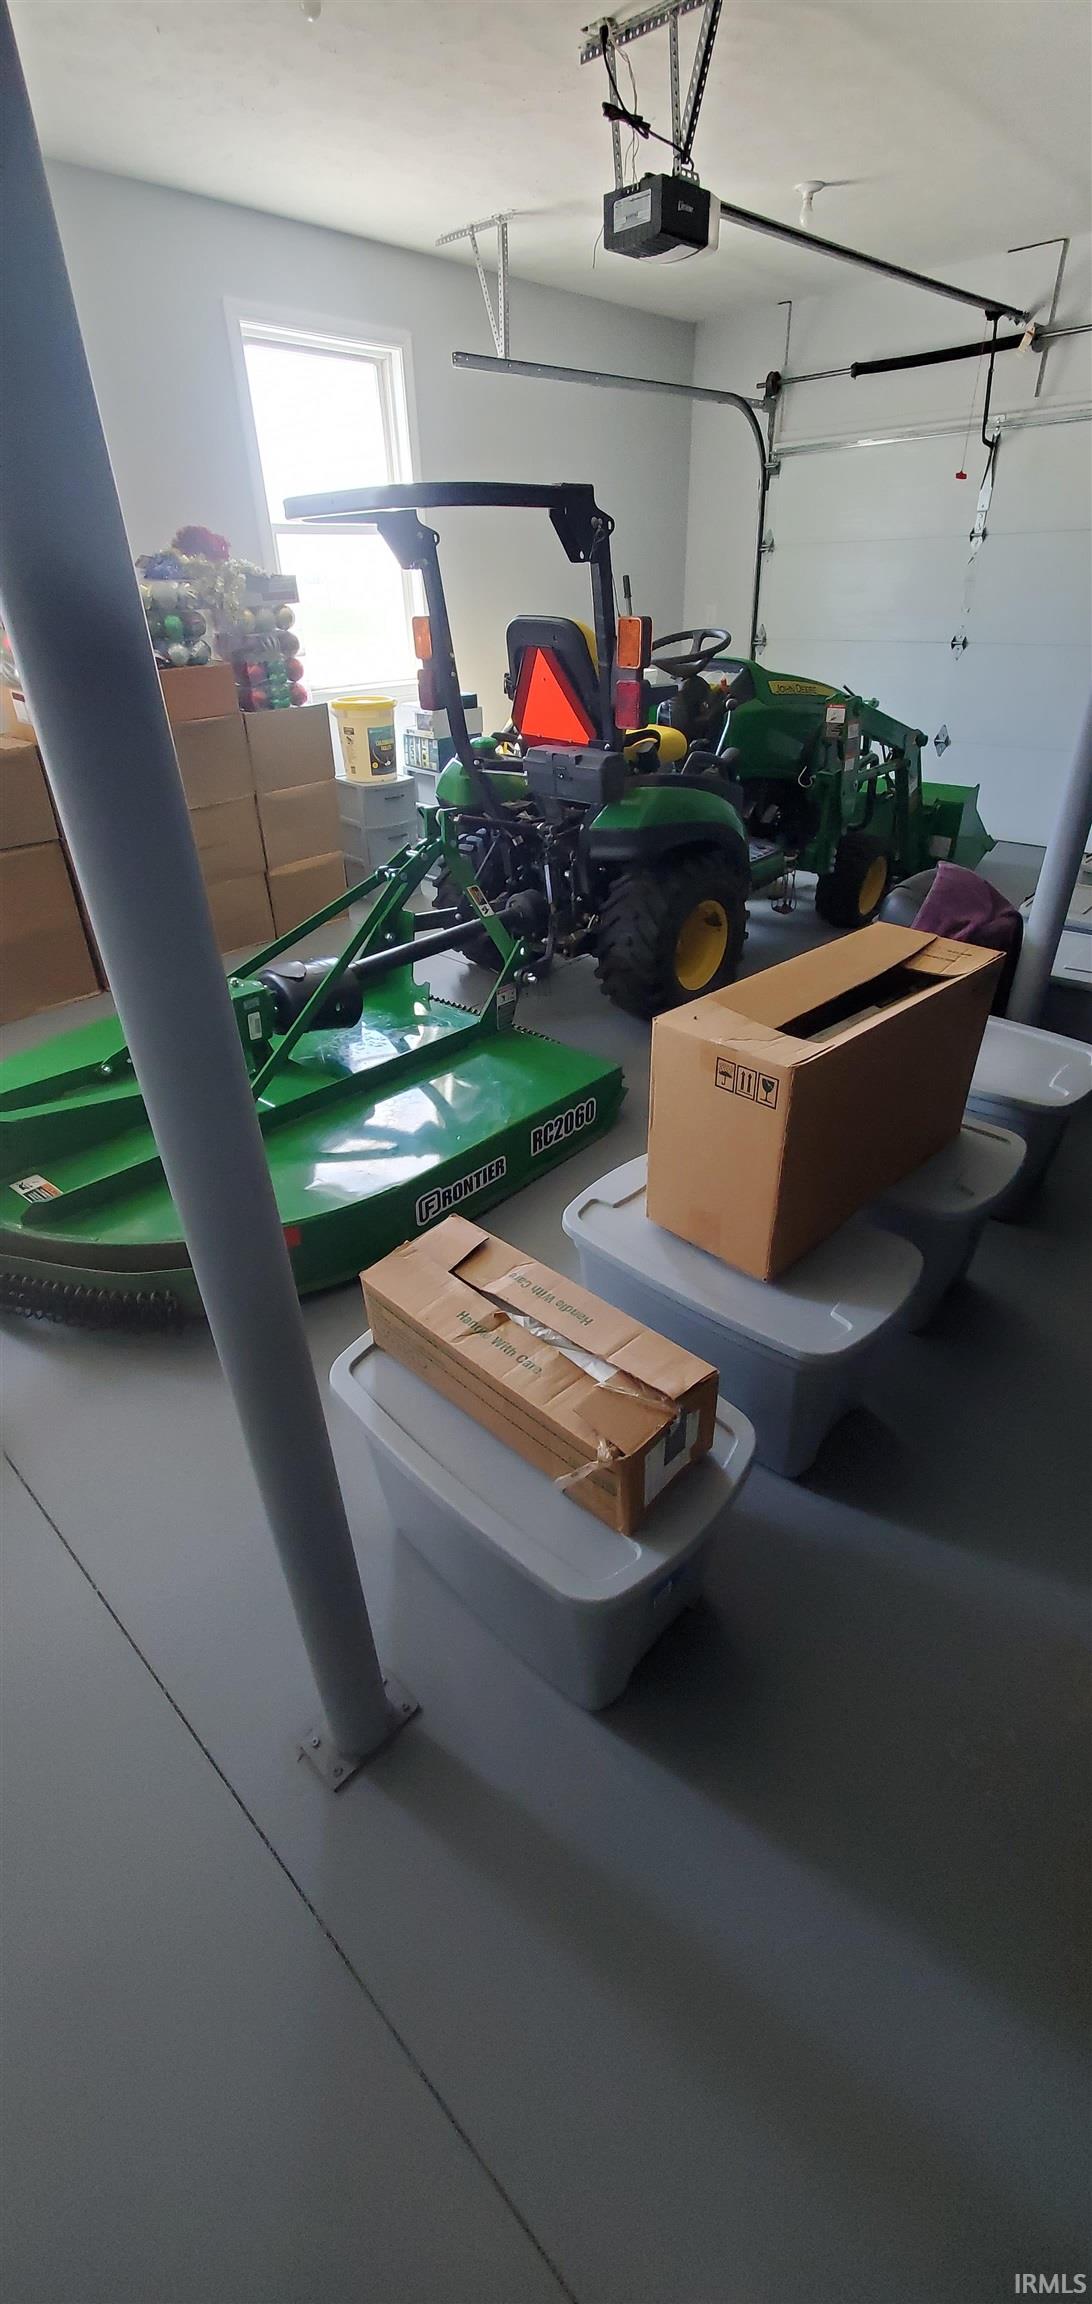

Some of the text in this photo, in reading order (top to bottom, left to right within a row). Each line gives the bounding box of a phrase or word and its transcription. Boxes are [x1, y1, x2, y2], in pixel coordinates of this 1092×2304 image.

[776, 684, 817, 694] JOHN DEERE
[531, 1098, 596, 1155] RC2060
[417, 1156, 506, 1225] FRONTIER
[509, 1272, 594, 1327] Handle With Care
[491, 1336, 517, 1357] With
[515, 1354, 543, 1375] Care
